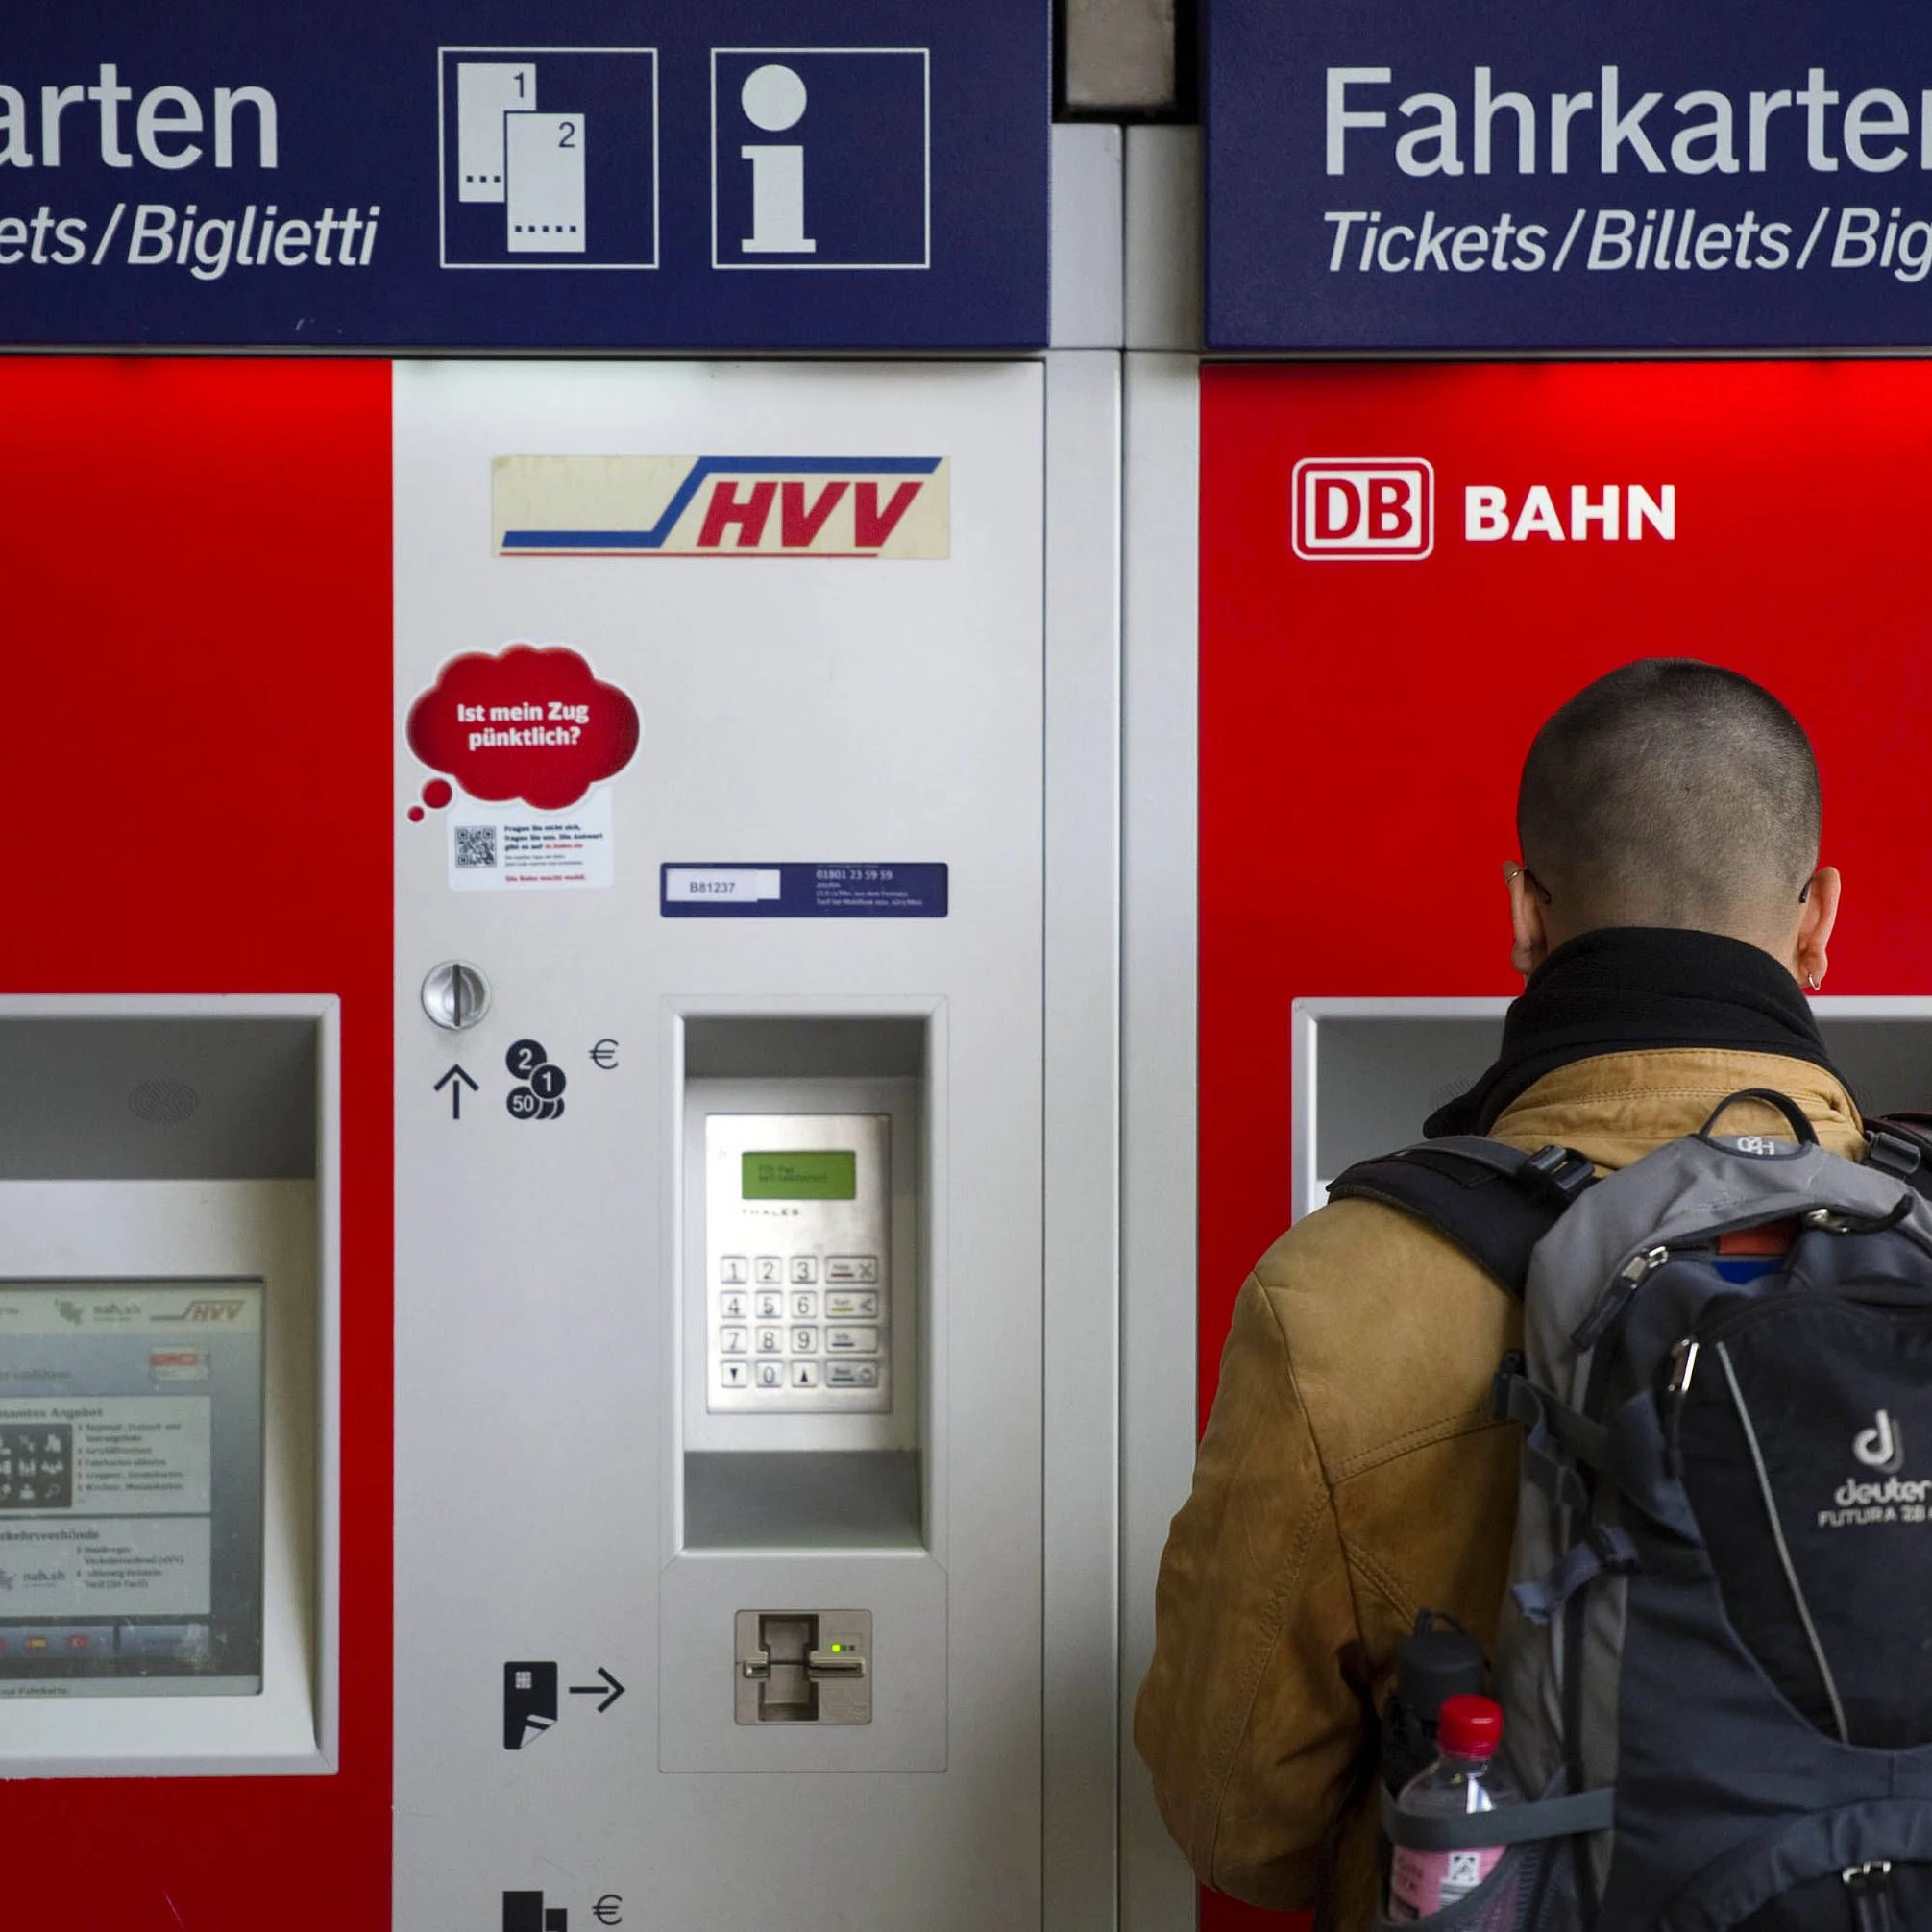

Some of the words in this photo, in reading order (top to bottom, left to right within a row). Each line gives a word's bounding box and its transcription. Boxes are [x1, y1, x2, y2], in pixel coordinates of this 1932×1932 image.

[513, 72, 526, 99] 1
[1325, 65, 1932, 177] Fahrkarte
[557, 121, 576, 148] 2
[697, 481, 924, 548] HVV
[1313, 478, 1414, 540] DB
[1464, 485, 1676, 541] BAHN
[457, 703, 485, 722] Ist
[489, 702, 543, 722] mein
[548, 701, 590, 724] Zug
[468, 726, 582, 751] pünktlich?
[690, 882, 736, 893] B81237
[518, 1048, 533, 1070] 2
[542, 1072, 552, 1092] 1
[512, 1095, 534, 1112] 50
[728, 1262, 738, 1280] 1
[763, 1262, 774, 1280] 2
[797, 1262, 810, 1280] 3
[727, 1298, 740, 1314] 4
[763, 1297, 774, 1314] 5
[797, 1297, 809, 1314] 6
[727, 1332, 739, 1350] 7
[763, 1331, 774, 1350] 8
[798, 1331, 810, 1349] 9
[1834, 1476, 1932, 1506] deuter
[1817, 1505, 1896, 1528] FUTURA
